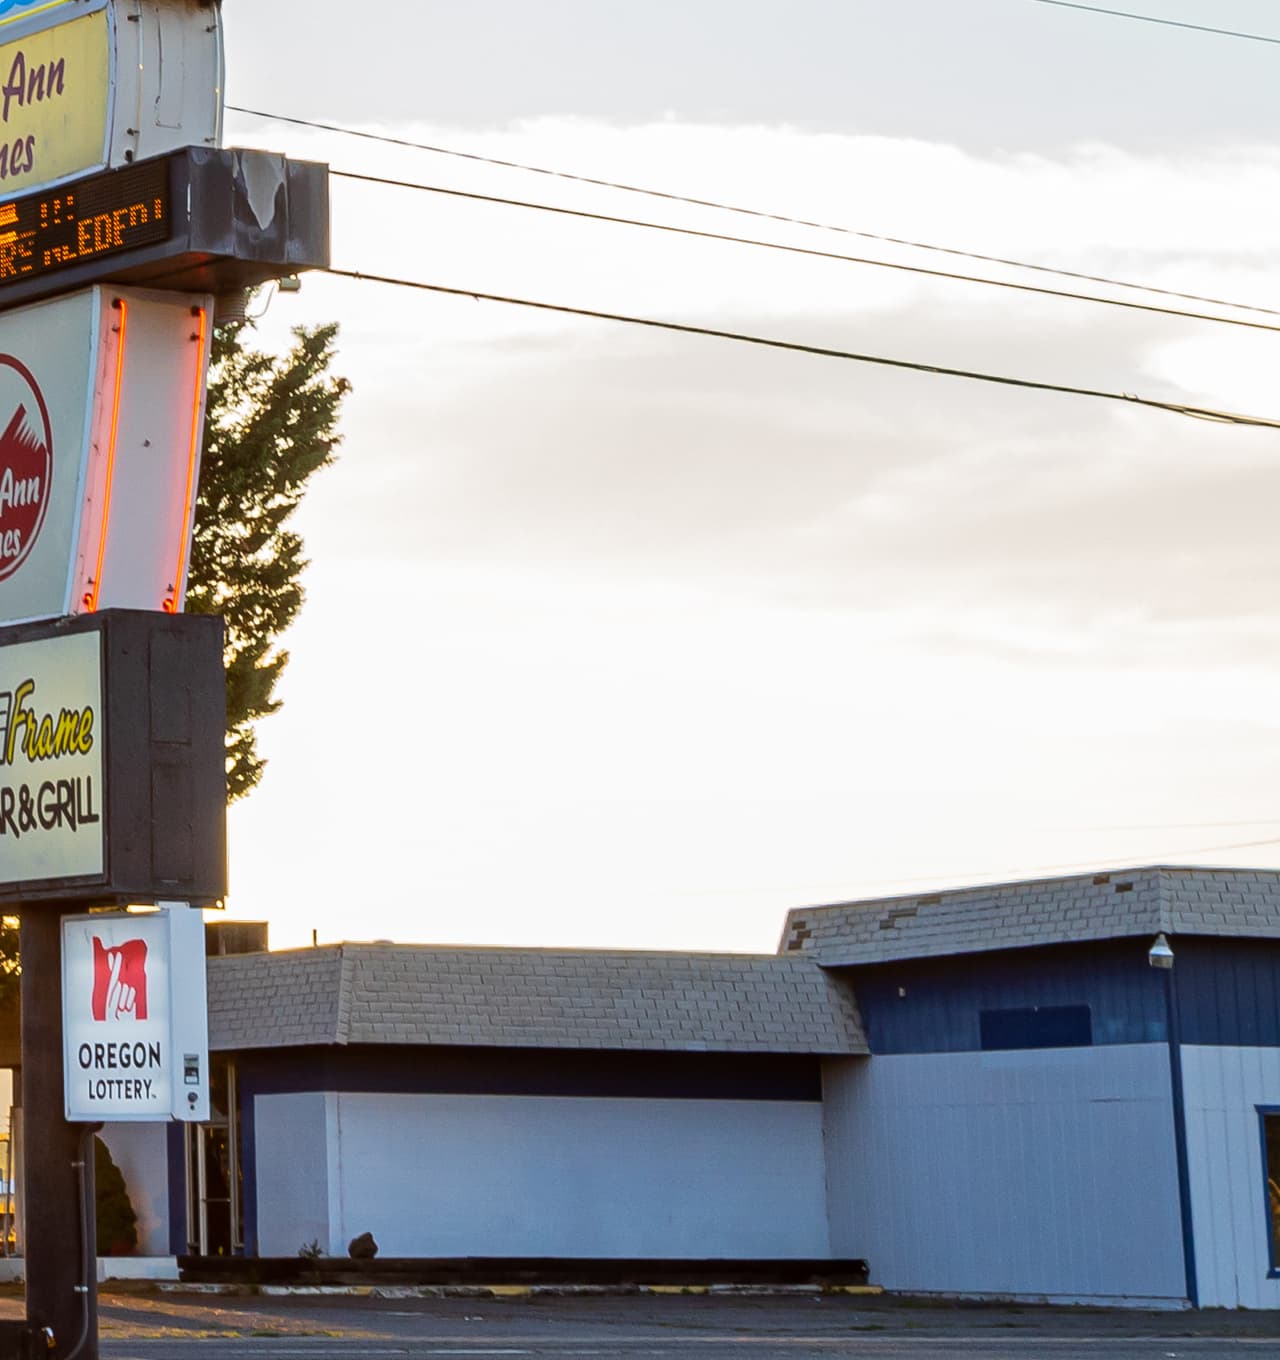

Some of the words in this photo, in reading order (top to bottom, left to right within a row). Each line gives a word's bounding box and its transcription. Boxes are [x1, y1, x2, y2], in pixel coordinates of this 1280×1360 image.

[2, 50, 65, 123] Ann
[7, 678, 94, 766] Frame
[18, 783, 38, 833] &
[37, 775, 100, 833] GRILL
[78, 1042, 161, 1070] OREGON
[88, 1079, 152, 1100] LOTTERY
